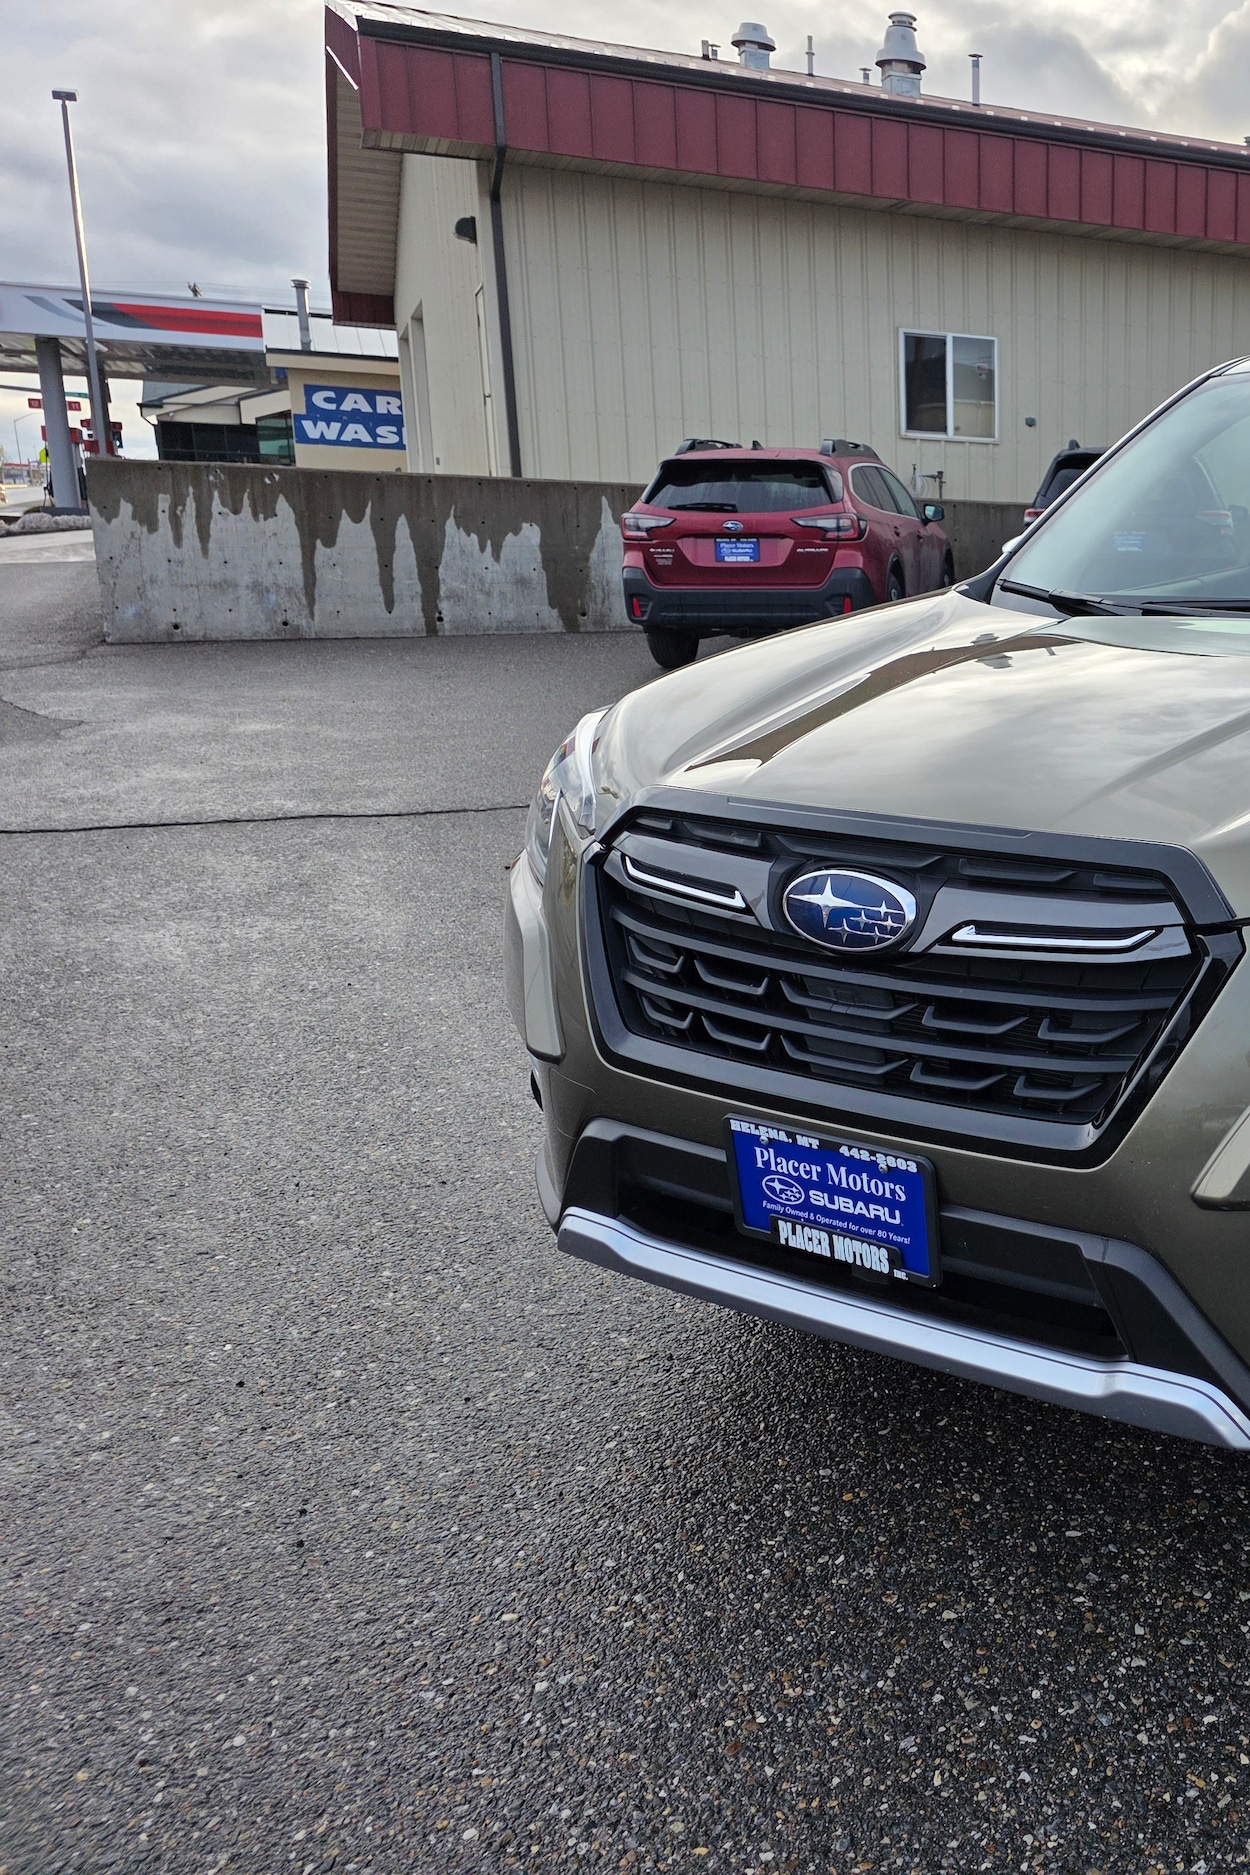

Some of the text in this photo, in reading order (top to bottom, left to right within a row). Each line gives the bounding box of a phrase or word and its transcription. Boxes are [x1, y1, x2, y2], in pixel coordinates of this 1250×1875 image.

[311, 390, 402, 415] CAR
[301, 420, 406, 446] WAS
[729, 1119, 793, 1144] HELENA,
[796, 1134, 819, 1150] MT
[754, 1146, 907, 1202] Placer Motors
[762, 1200, 911, 1245] Family Owned & Operated for over 80 Years!
[808, 1189, 901, 1226] SUBARU
[777, 1219, 831, 1258] PLACER
[832, 1233, 890, 1275] MOTORS
